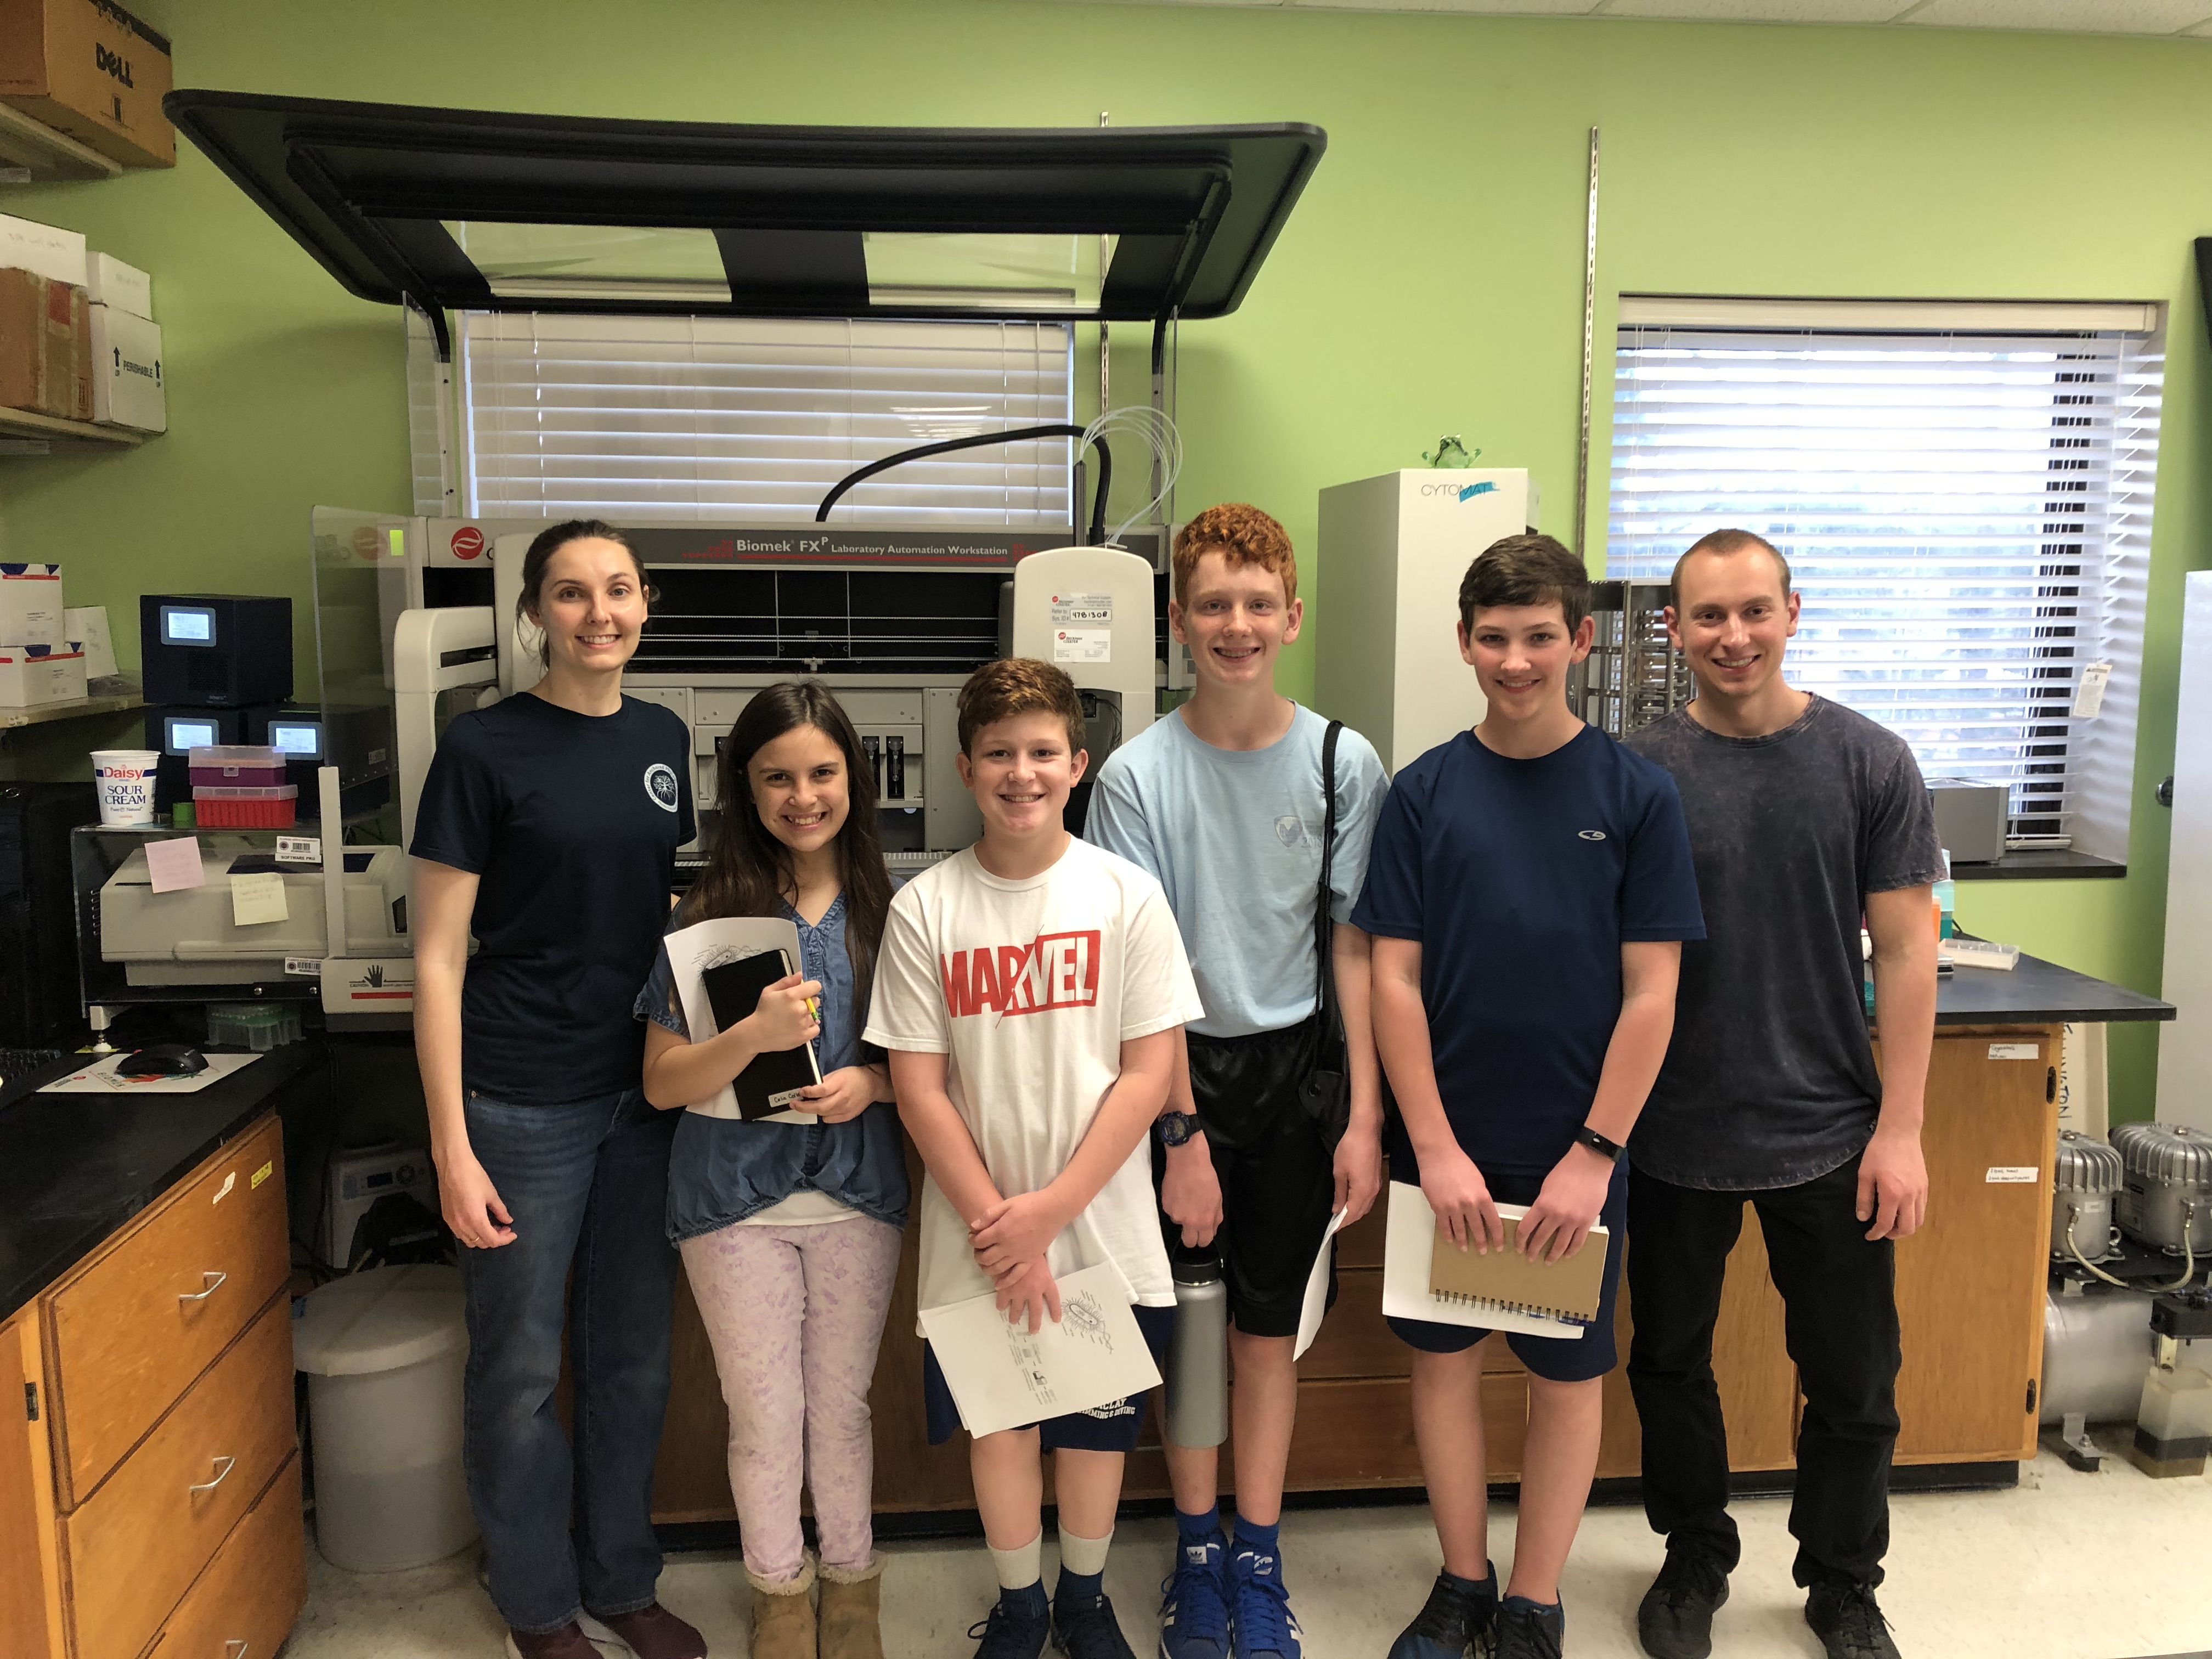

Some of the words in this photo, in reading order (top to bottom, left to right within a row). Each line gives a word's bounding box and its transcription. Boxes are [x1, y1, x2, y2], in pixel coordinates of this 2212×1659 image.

[95, 42, 133, 89] DELL
[123, 360, 153, 378] PERISHABLE
[831, 544, 884, 555] Laboratory
[888, 544, 945, 554] Automation
[947, 545, 1008, 555] Workstation
[104, 767, 143, 781] Daisy
[107, 785, 143, 795] SOUR
[105, 795, 146, 805] CREAM
[940, 933, 1099, 1018] MARVEL
[1076, 1408, 1109, 1420] MMING
[1114, 1406, 1136, 1417] DIVING
